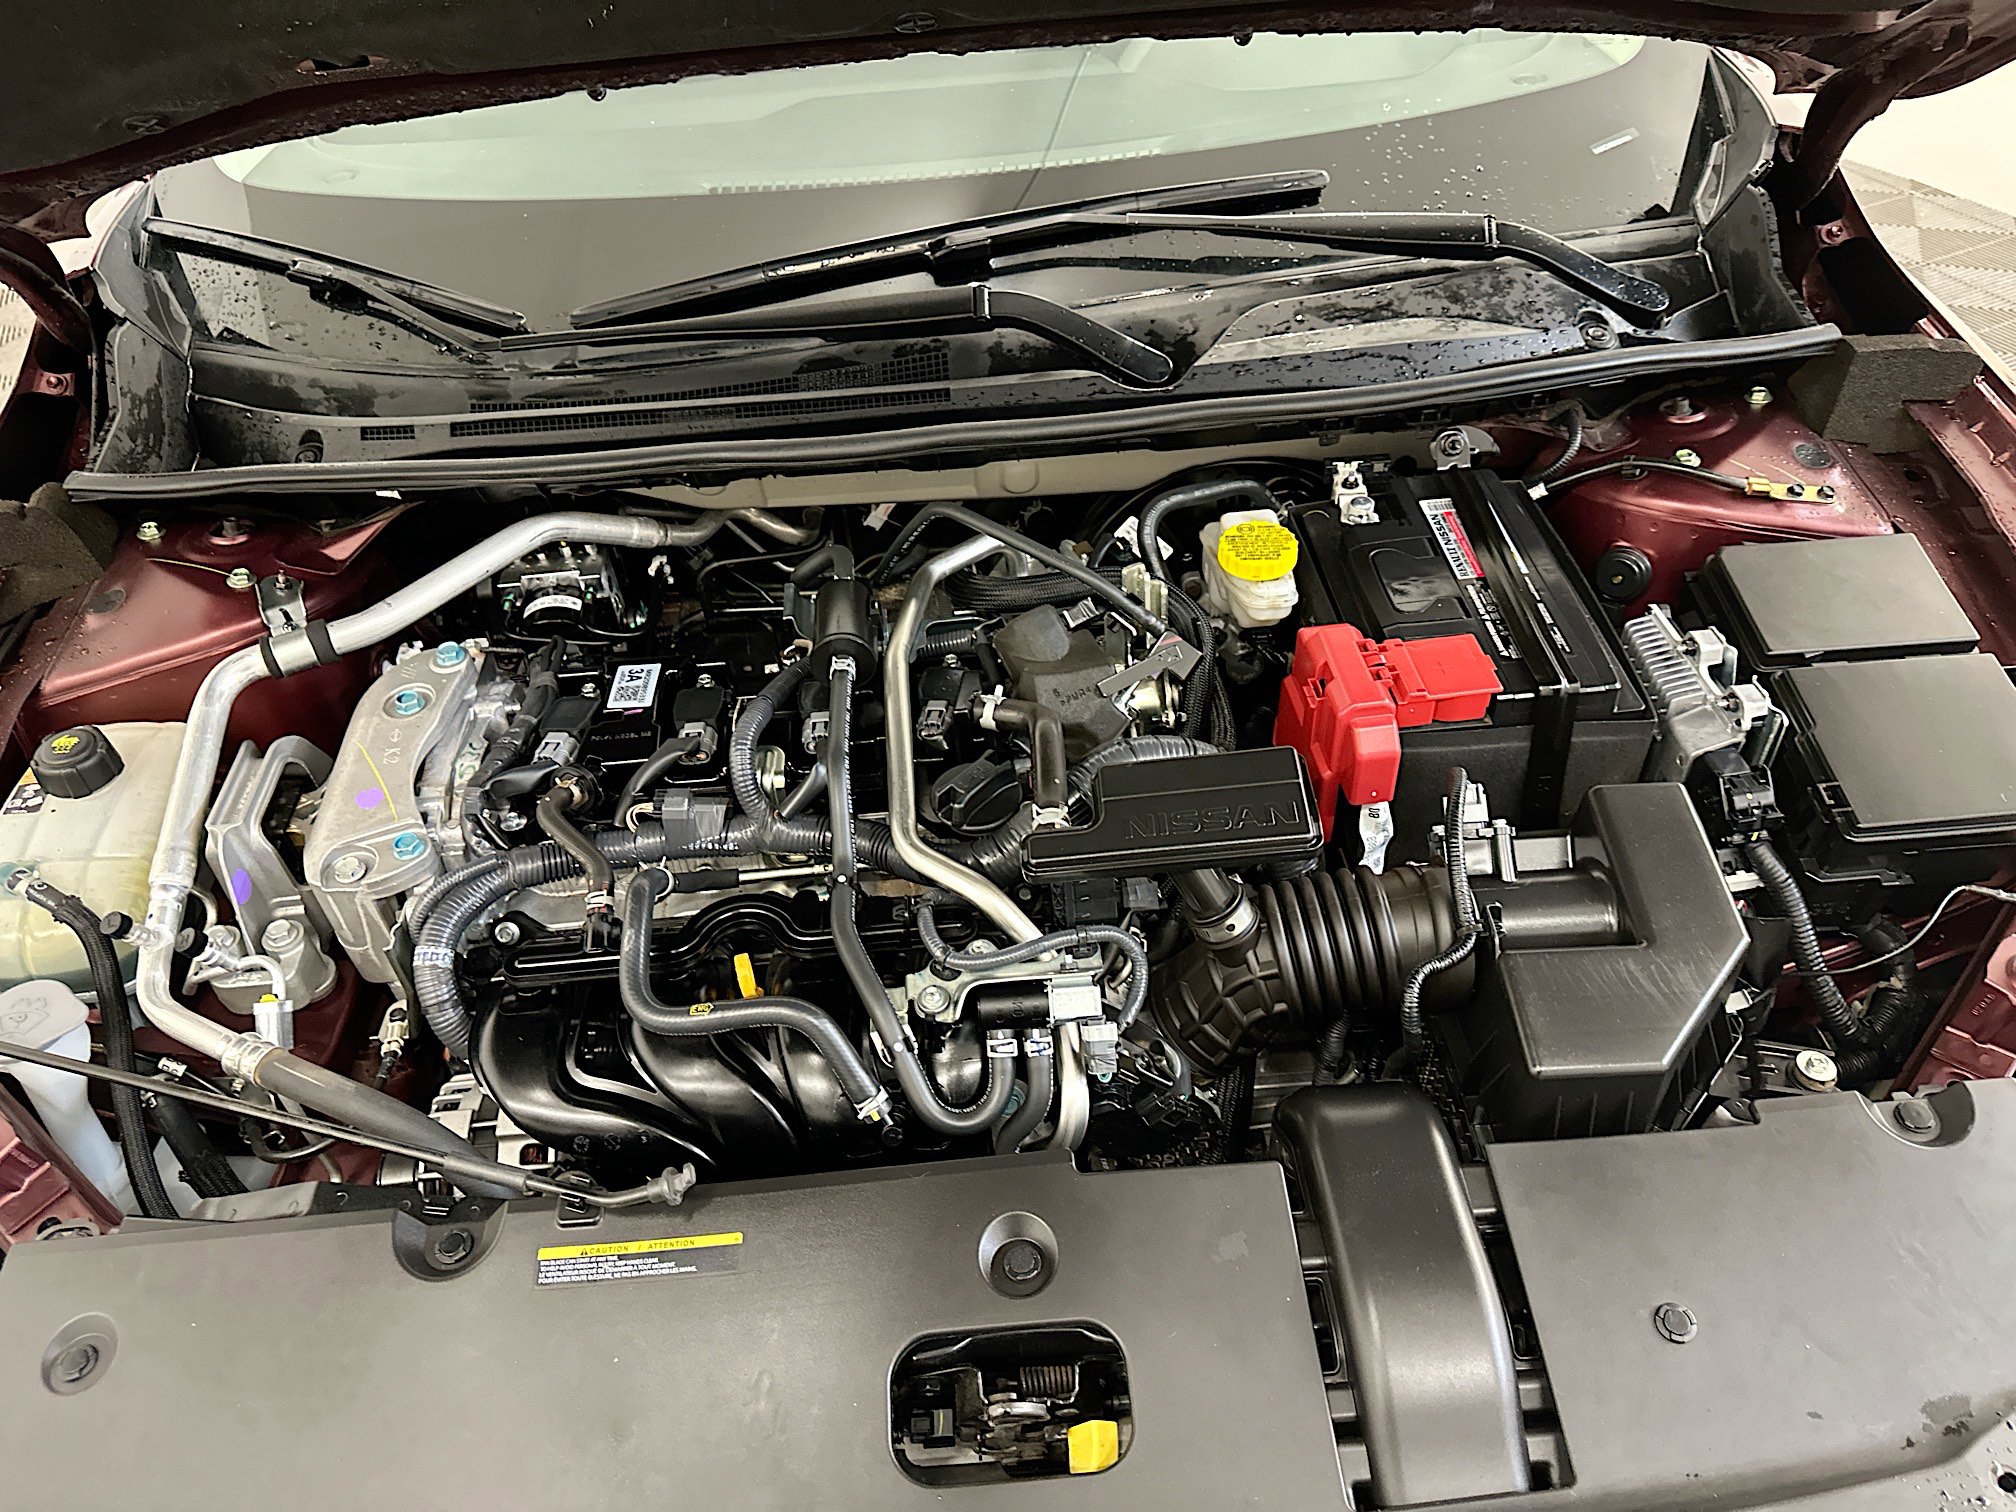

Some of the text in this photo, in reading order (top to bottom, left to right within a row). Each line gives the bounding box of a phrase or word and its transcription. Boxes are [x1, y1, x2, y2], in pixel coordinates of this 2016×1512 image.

[1430, 514, 1453, 546] NISSAN
[626, 668, 644, 683] 3A
[1125, 801, 1300, 839] NISSAN
[692, 1005, 709, 1013] ENG
[589, 1246, 629, 1254] CAUTION
[648, 1240, 695, 1249] ATTENTION
